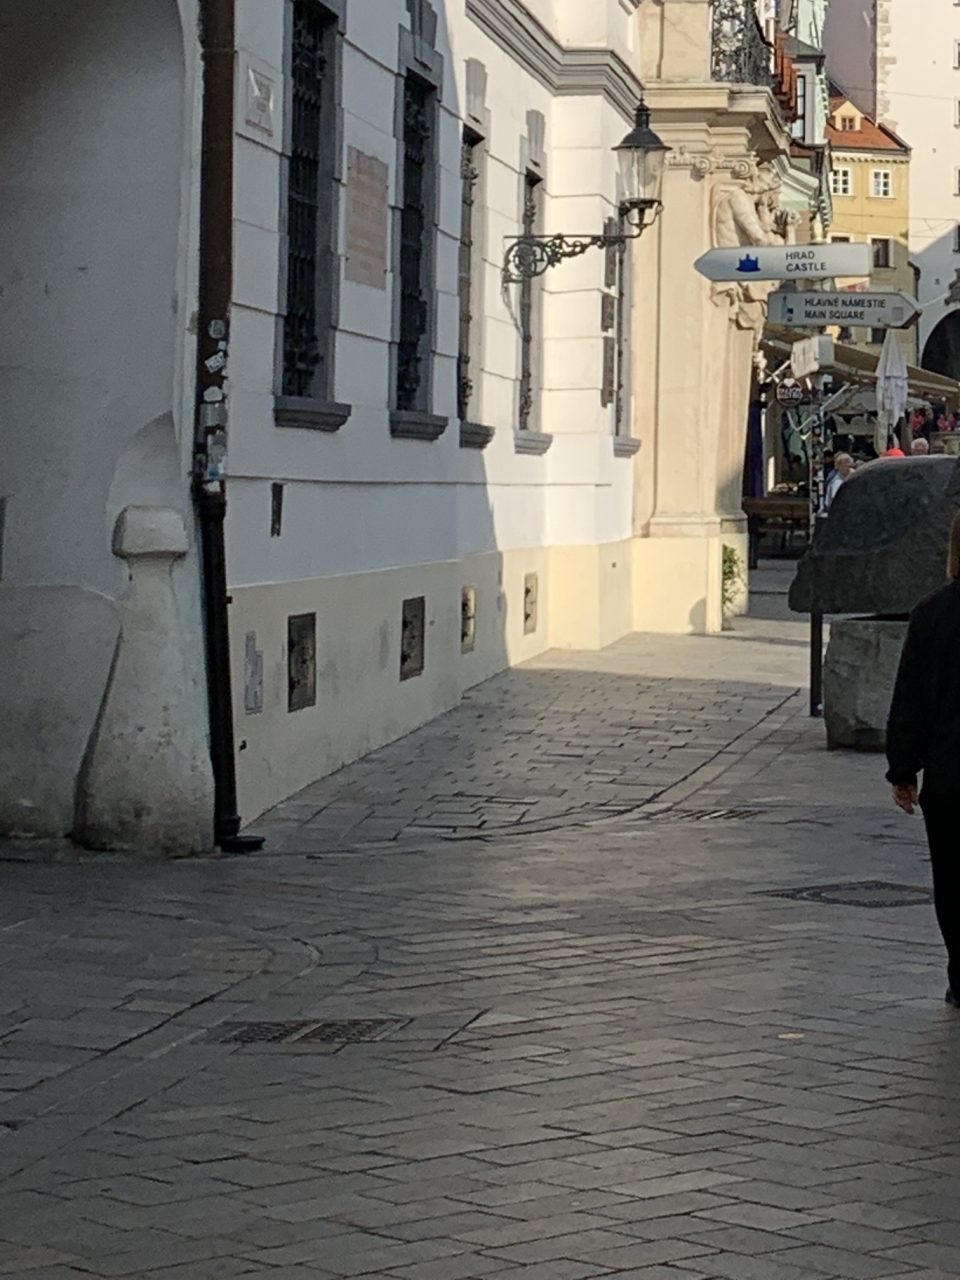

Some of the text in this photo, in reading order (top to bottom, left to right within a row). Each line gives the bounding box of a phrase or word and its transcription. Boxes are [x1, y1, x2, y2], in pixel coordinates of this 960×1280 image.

[785, 251, 815, 260] HRAD
[786, 262, 827, 272] CASTLE
[804, 297, 887, 308] HLAVNÉ NÁMESTIE
[804, 310, 865, 320] MAIN SQUARE
